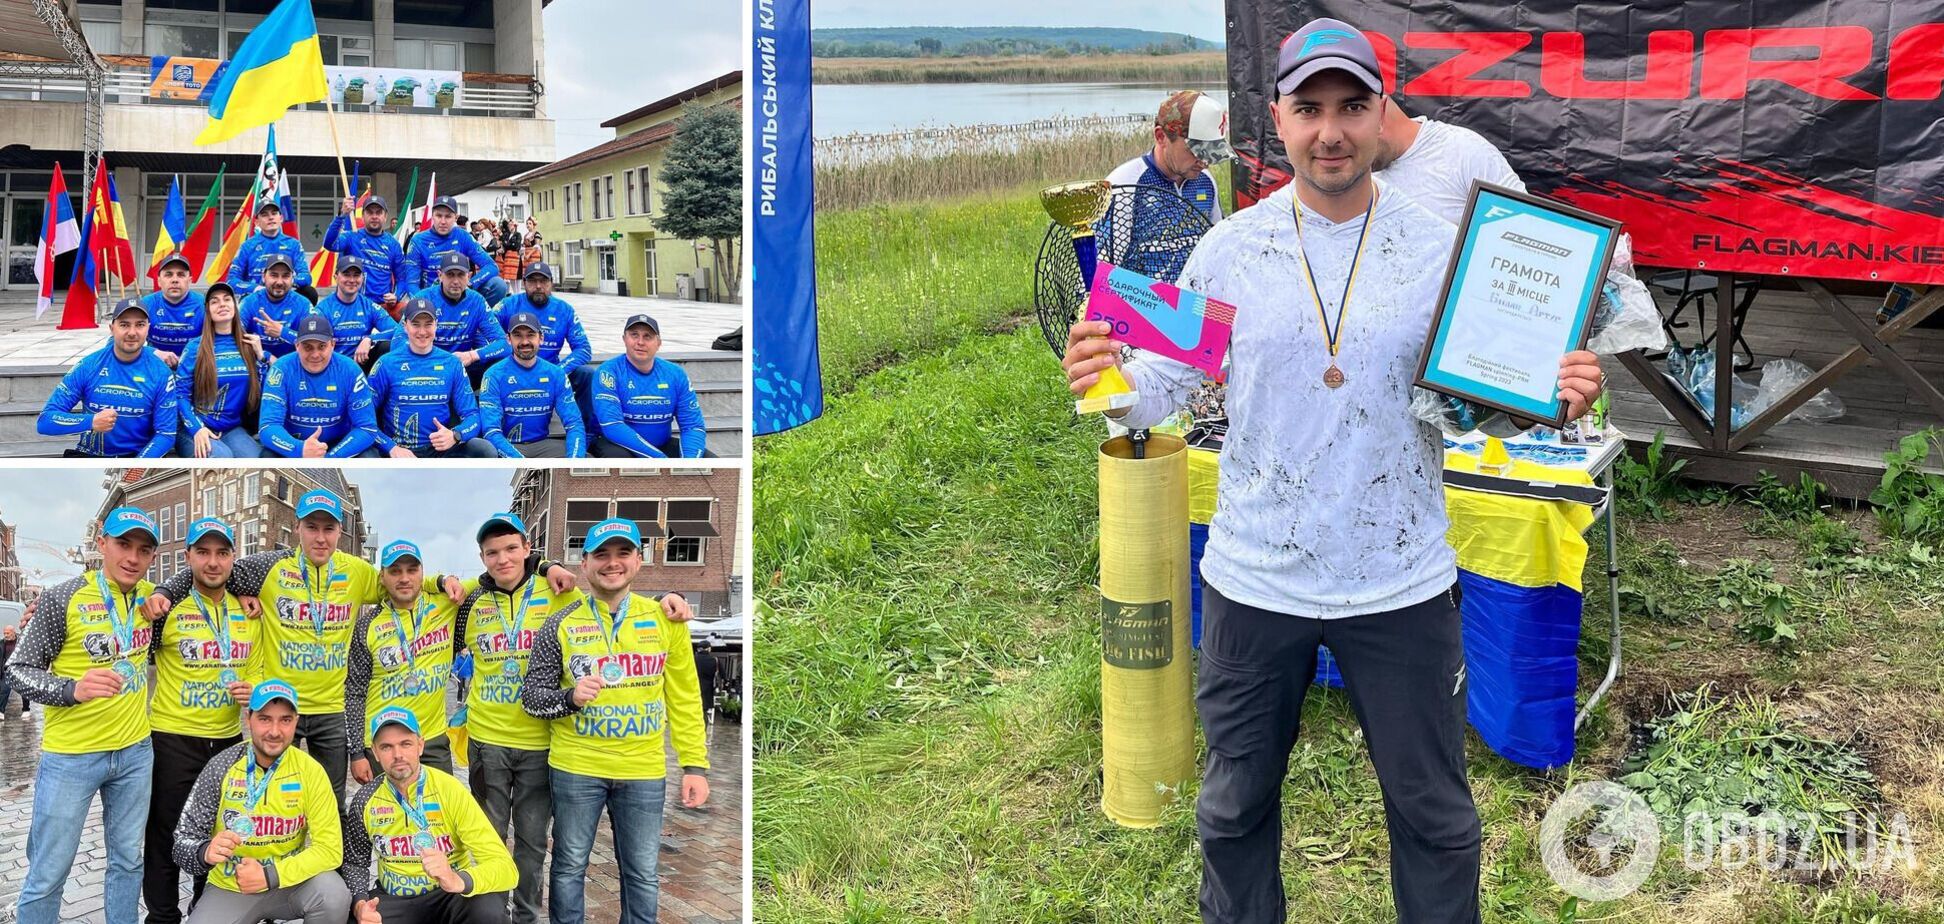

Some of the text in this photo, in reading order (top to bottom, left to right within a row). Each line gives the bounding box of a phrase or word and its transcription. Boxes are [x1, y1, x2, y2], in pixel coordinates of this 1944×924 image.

[757, 38, 778, 216] РИБАЛЬСЬКИЙ
[1692, 234, 1944, 265] FLAGMAN.KIE
[1490, 256, 1560, 288] ГРАМОТА
[1098, 285, 1158, 311] СЕРТИФИКАТ
[1491, 279, 1505, 291] ЗА
[1517, 287, 1551, 304] МІСЦЕ
[93, 386, 144, 398] ACROPOLIS
[290, 414, 341, 423] AZURA
[504, 405, 551, 413] AZURA
[90, 614, 110, 622] FSF
[280, 651, 347, 671] UKRAINE
[183, 681, 226, 691] NATION
[484, 675, 523, 685] NATIONA
[181, 690, 237, 709] UKRAI
[480, 685, 523, 704] UKRA
